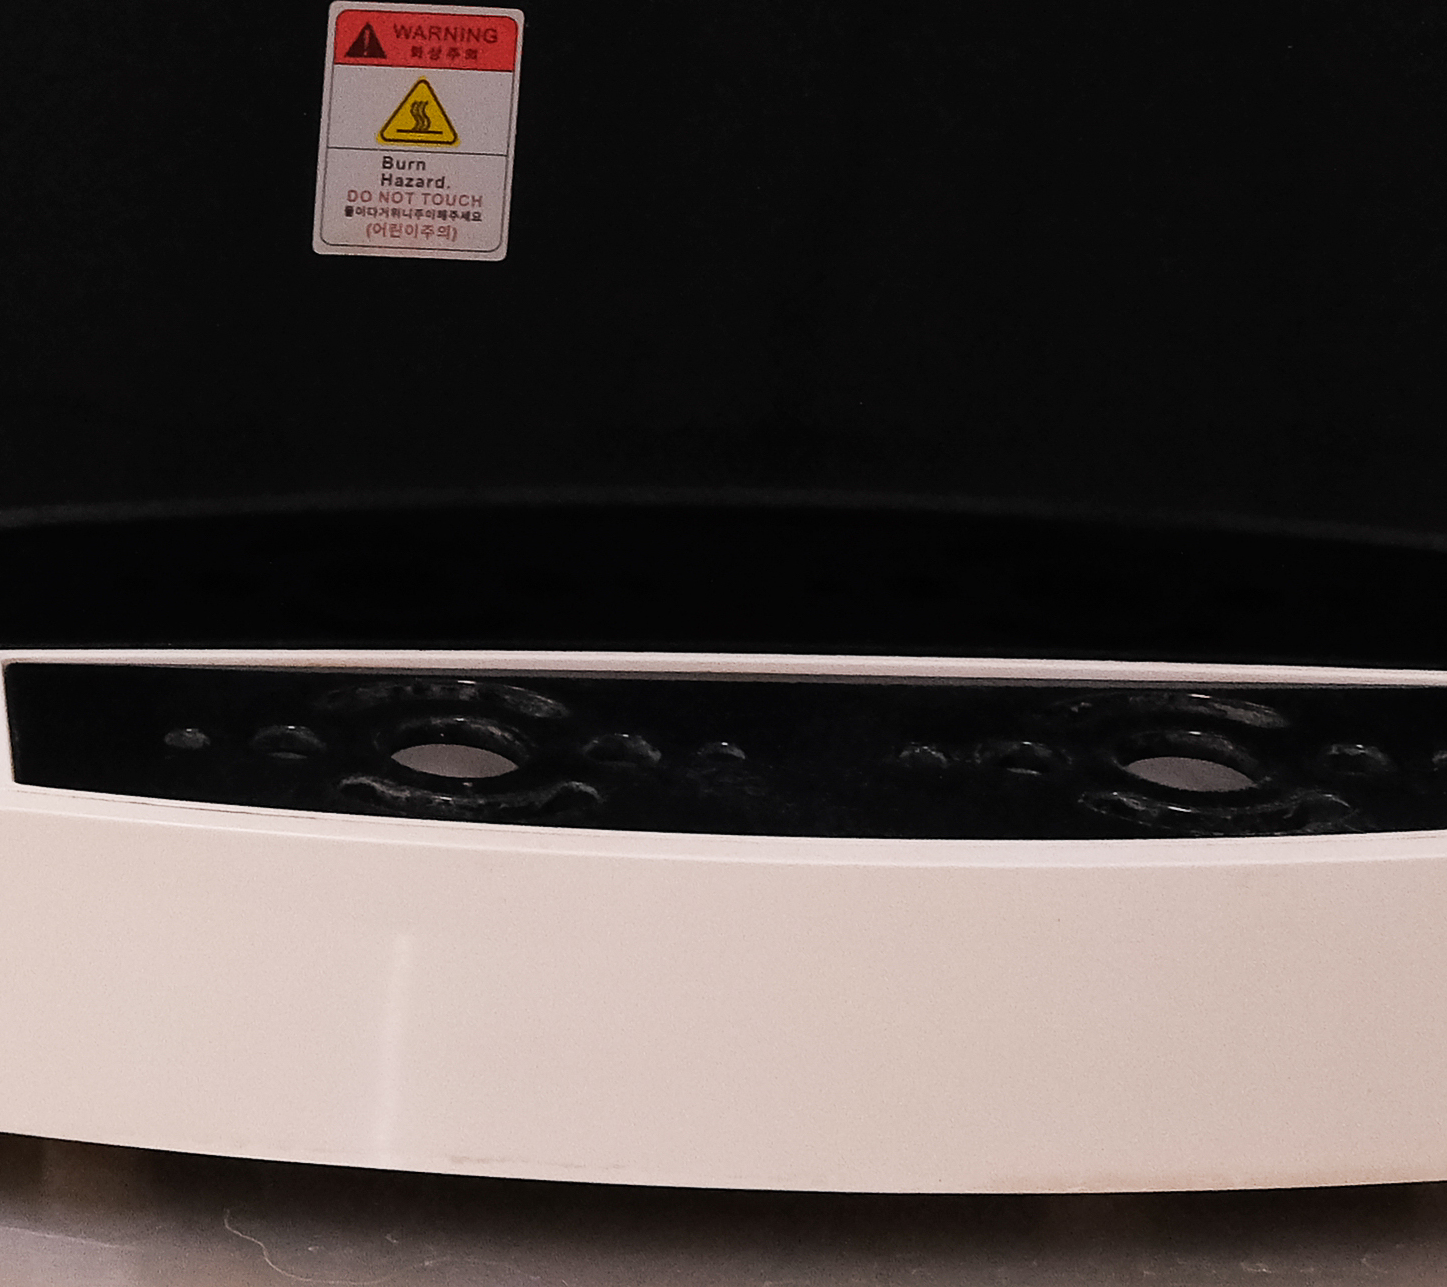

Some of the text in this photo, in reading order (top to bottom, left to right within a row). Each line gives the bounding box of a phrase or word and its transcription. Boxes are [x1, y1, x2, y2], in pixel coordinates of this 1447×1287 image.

[393, 23, 498, 44] WARNING
[382, 155, 426, 171] Burn
[380, 173, 451, 189] Hazard.
[346, 189, 484, 208] DO NOT TOUCH
[366, 222, 458, 243] (어린이주의)
